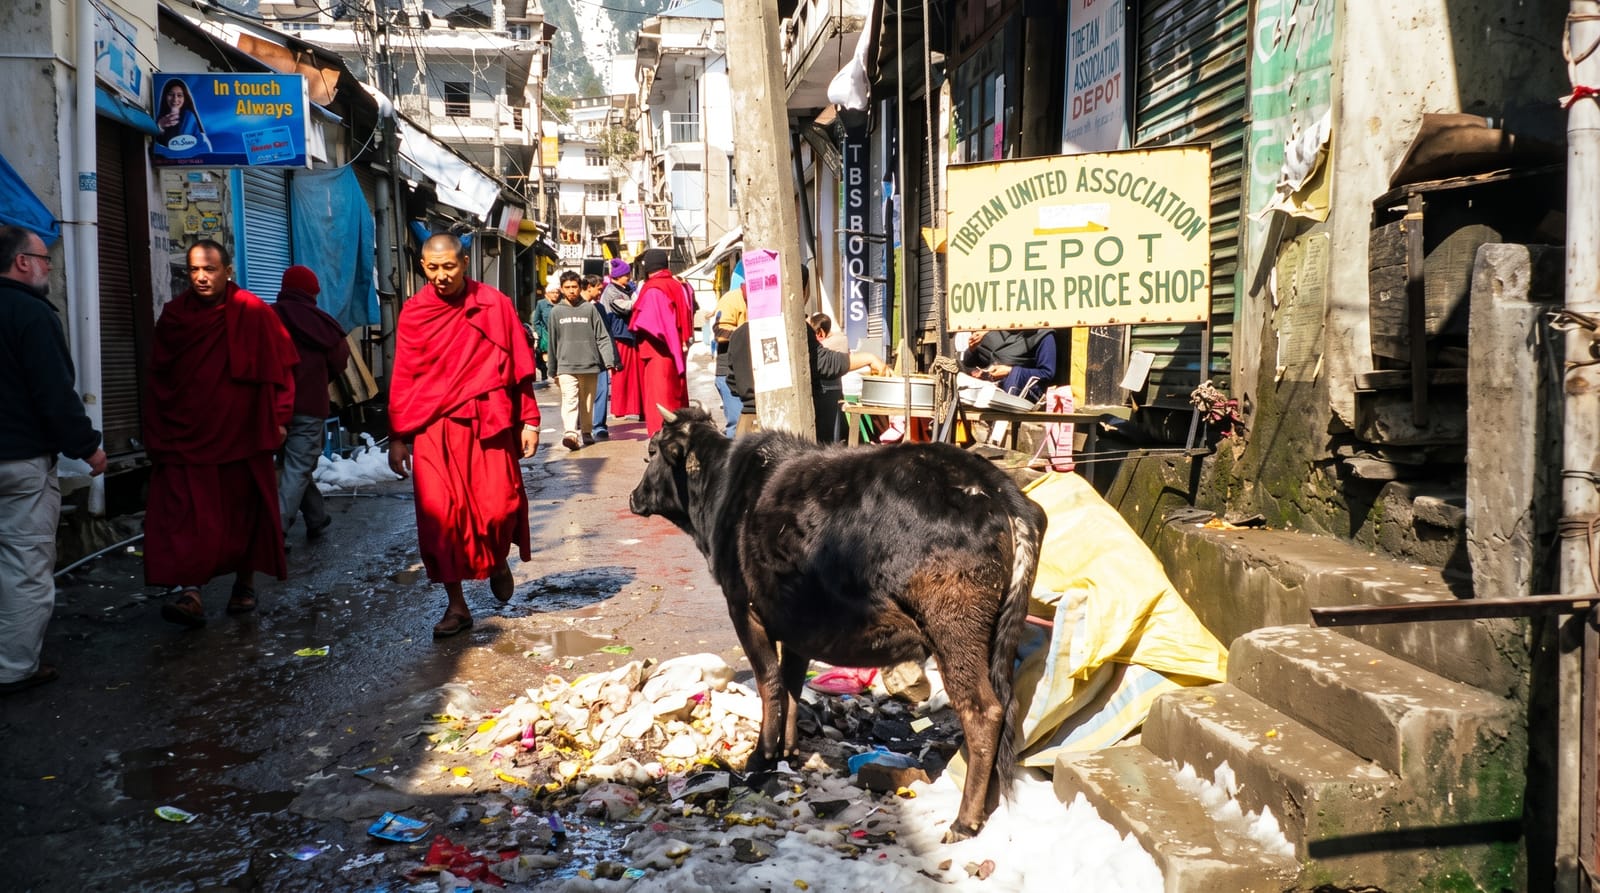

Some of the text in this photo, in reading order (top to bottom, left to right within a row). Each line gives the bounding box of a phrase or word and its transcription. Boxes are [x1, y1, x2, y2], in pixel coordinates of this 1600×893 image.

[1072, 16, 1099, 60] TIBETAN
[1073, 37, 1120, 93] ASSOCIATION
[213, 79, 281, 96] In touch
[235, 99, 293, 119] Always
[1072, 72, 1121, 120] DEPOT
[848, 144, 864, 322] TBS BOOKS
[950, 166, 1207, 256] TIBETAN UNITED ASSOCIATION
[989, 233, 1162, 273] DEPOT
[1064, 272, 1132, 309] PRICE
[1139, 269, 1206, 305] SHOP
